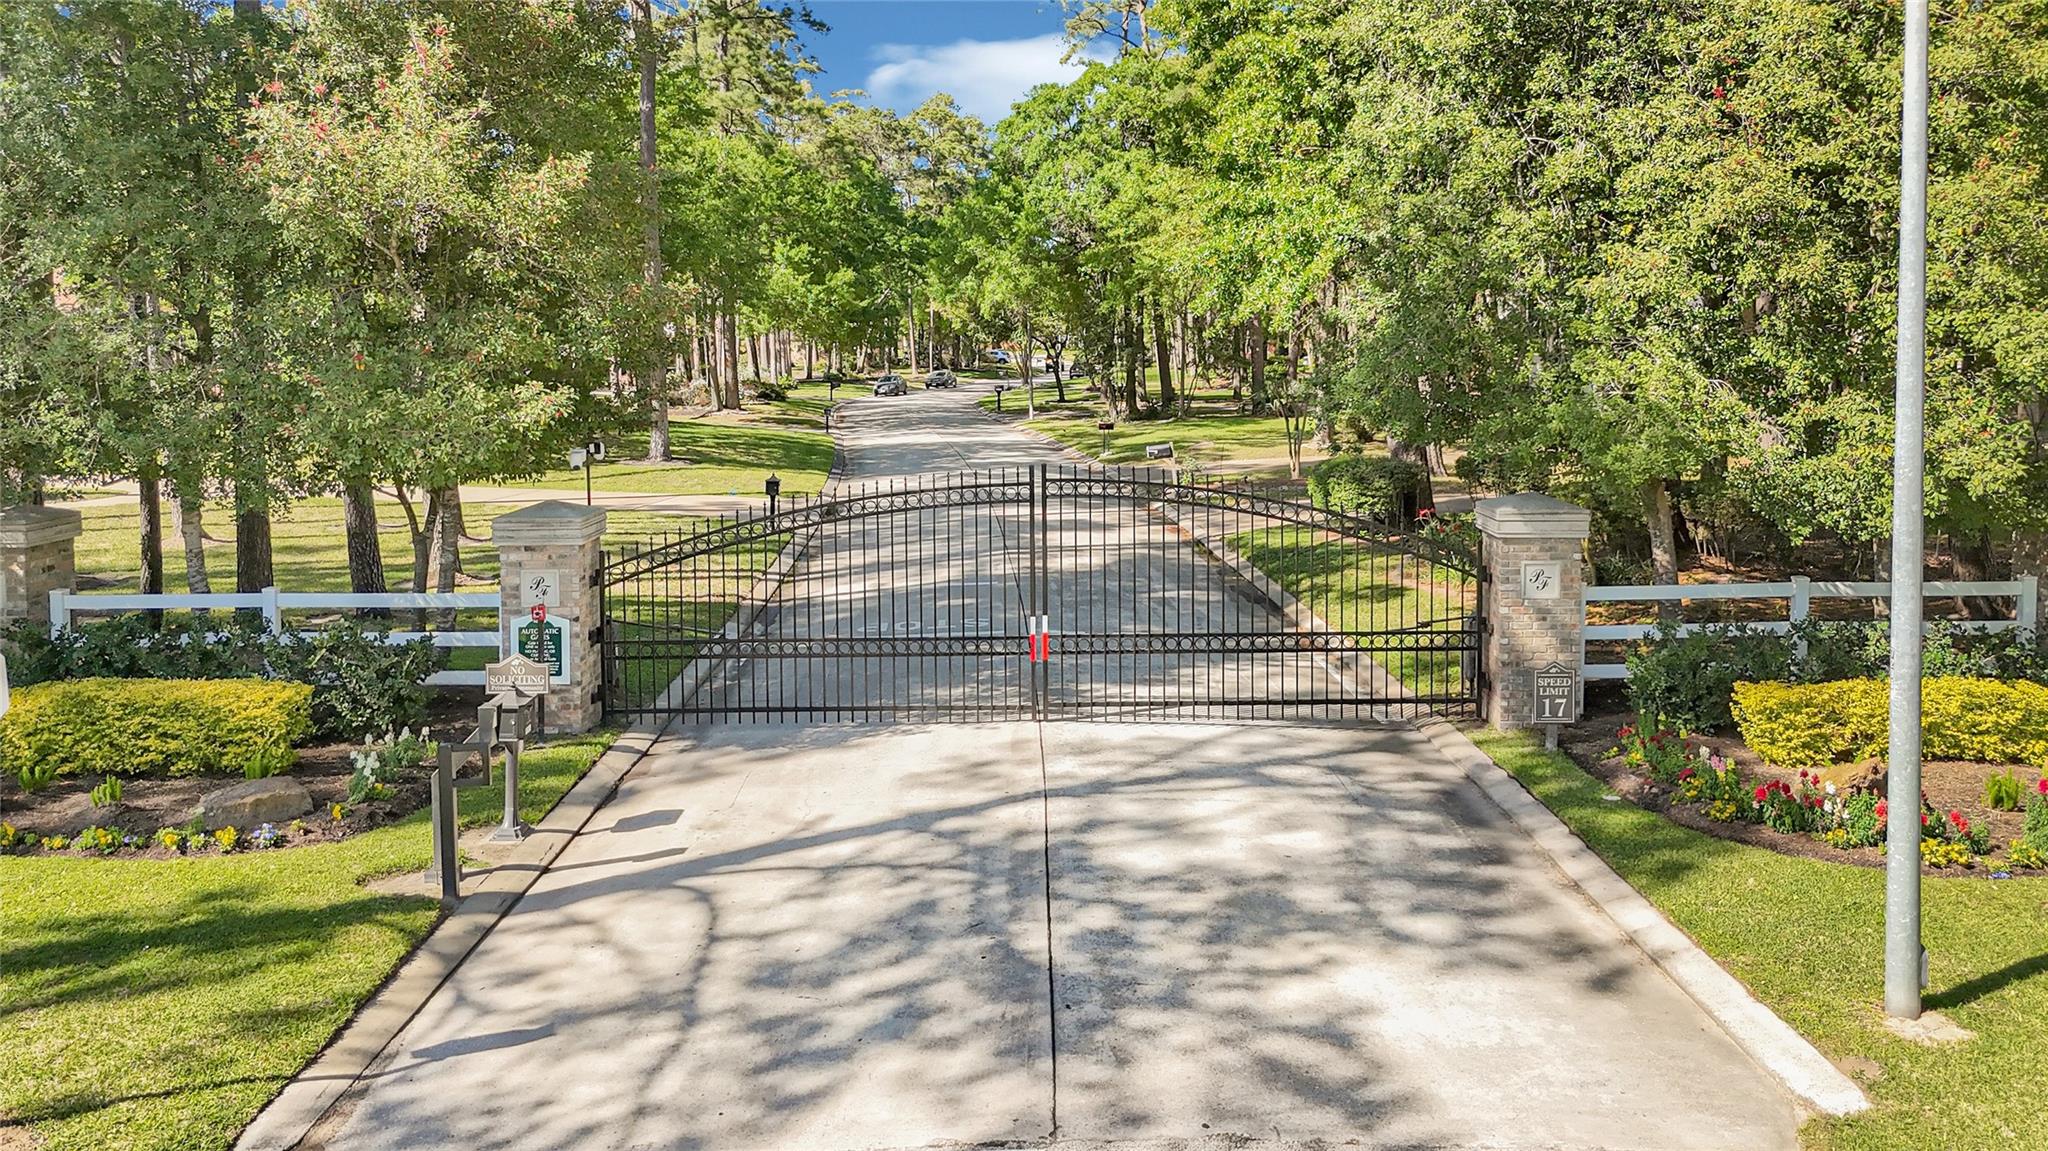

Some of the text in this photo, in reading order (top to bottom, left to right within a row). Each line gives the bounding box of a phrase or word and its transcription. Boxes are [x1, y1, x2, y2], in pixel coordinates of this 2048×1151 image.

[510, 666, 525, 675] NO
[489, 675, 545, 685] SOLICITING
[1537, 677, 1571, 687] SPEED
[1539, 687, 1570, 696] LIMIT
[1541, 698, 1567, 717] 17
